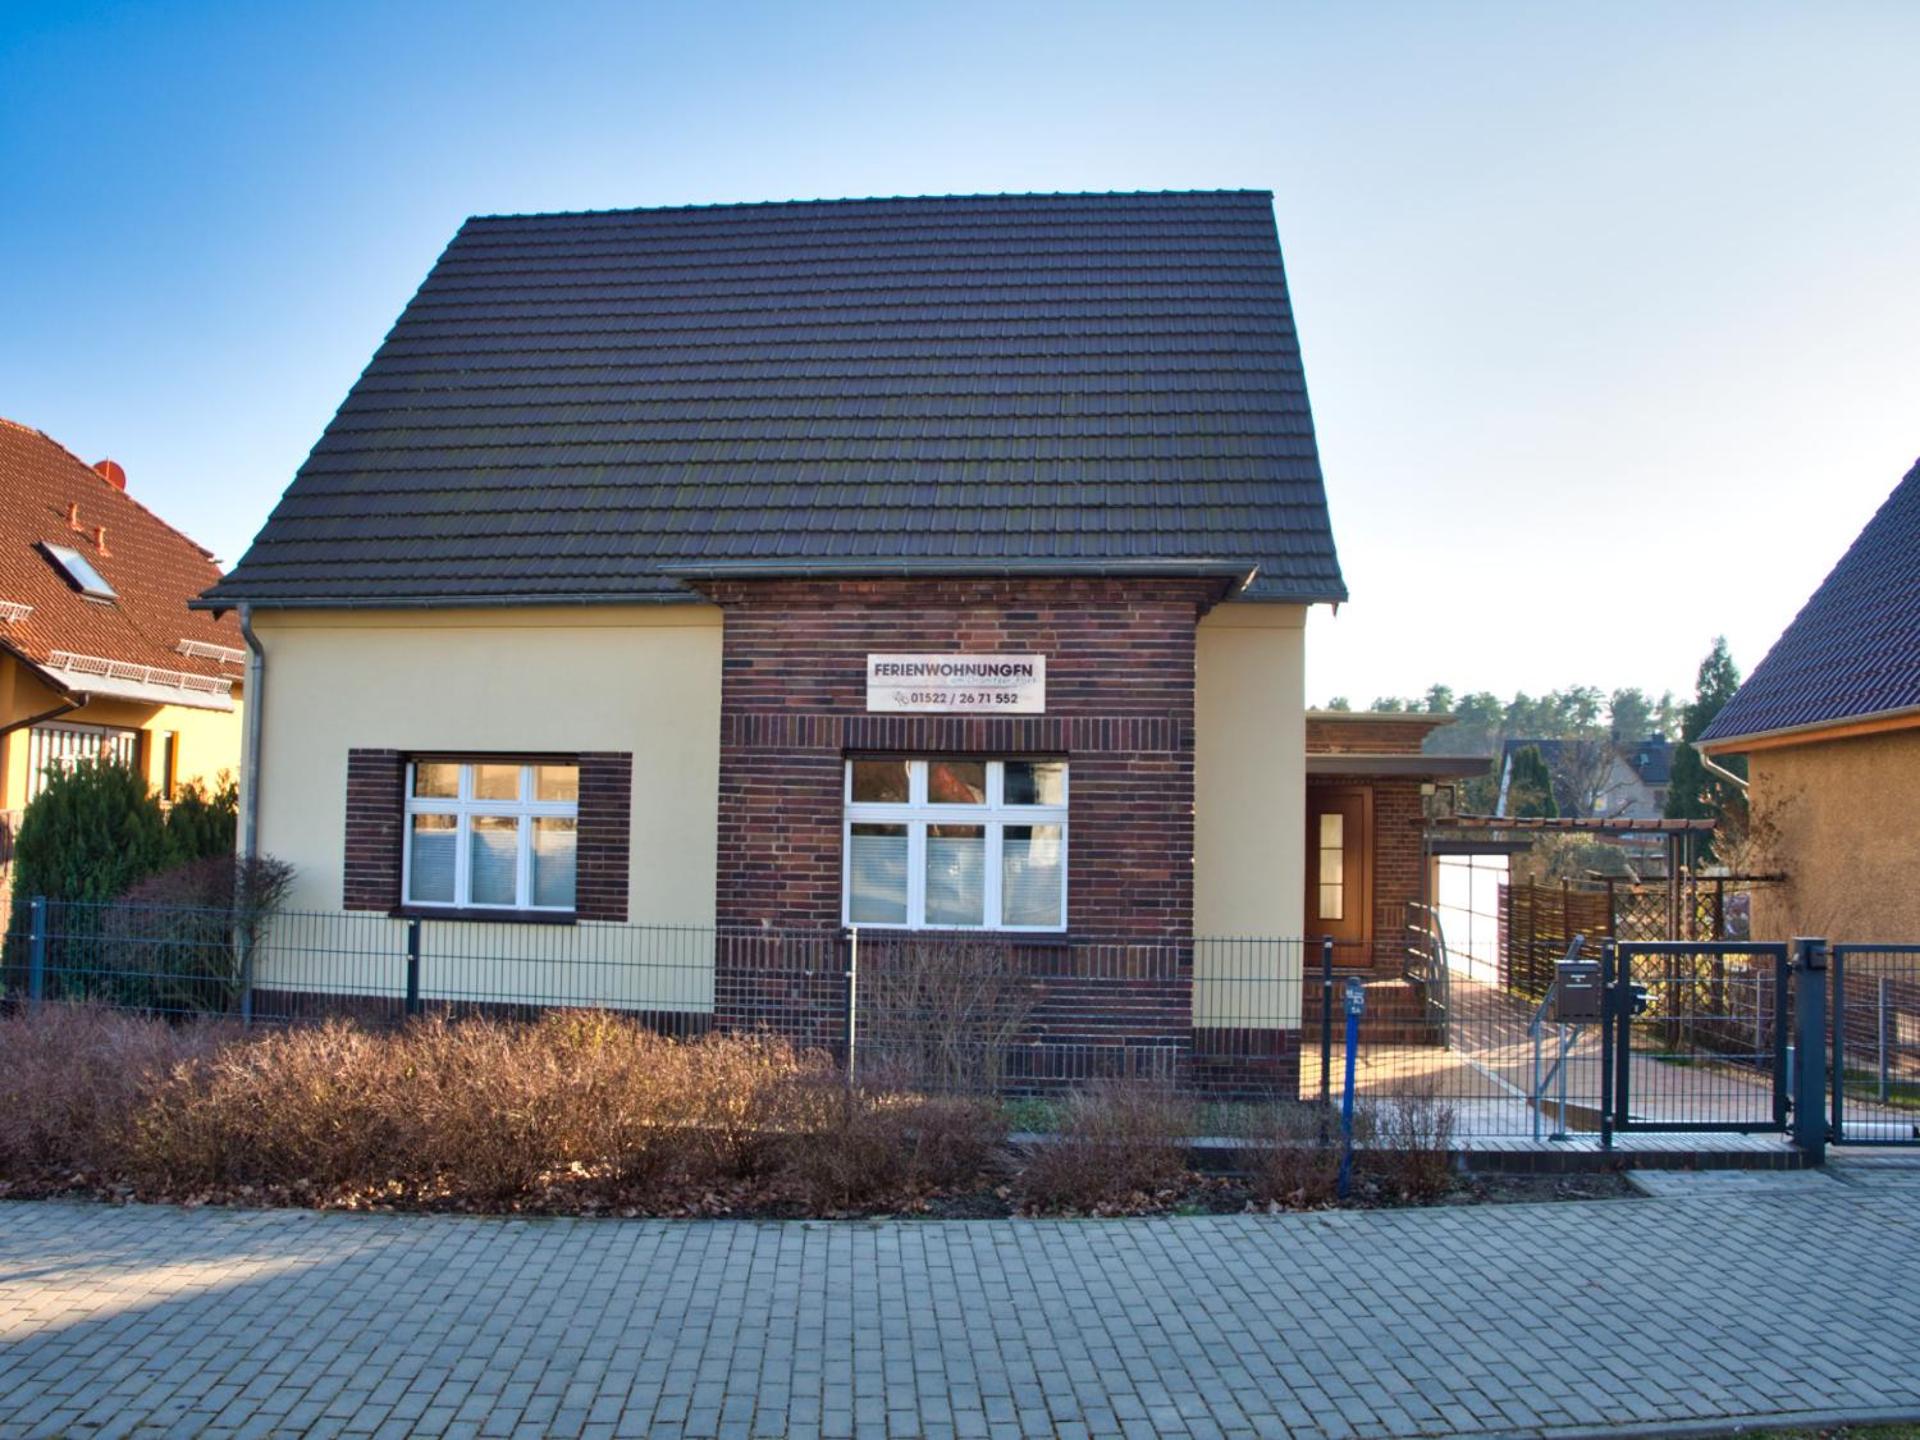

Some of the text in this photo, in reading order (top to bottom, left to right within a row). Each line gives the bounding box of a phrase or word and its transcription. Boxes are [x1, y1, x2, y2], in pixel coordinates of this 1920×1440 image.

[911, 693, 1018, 705] 01522 / 26 71 552
